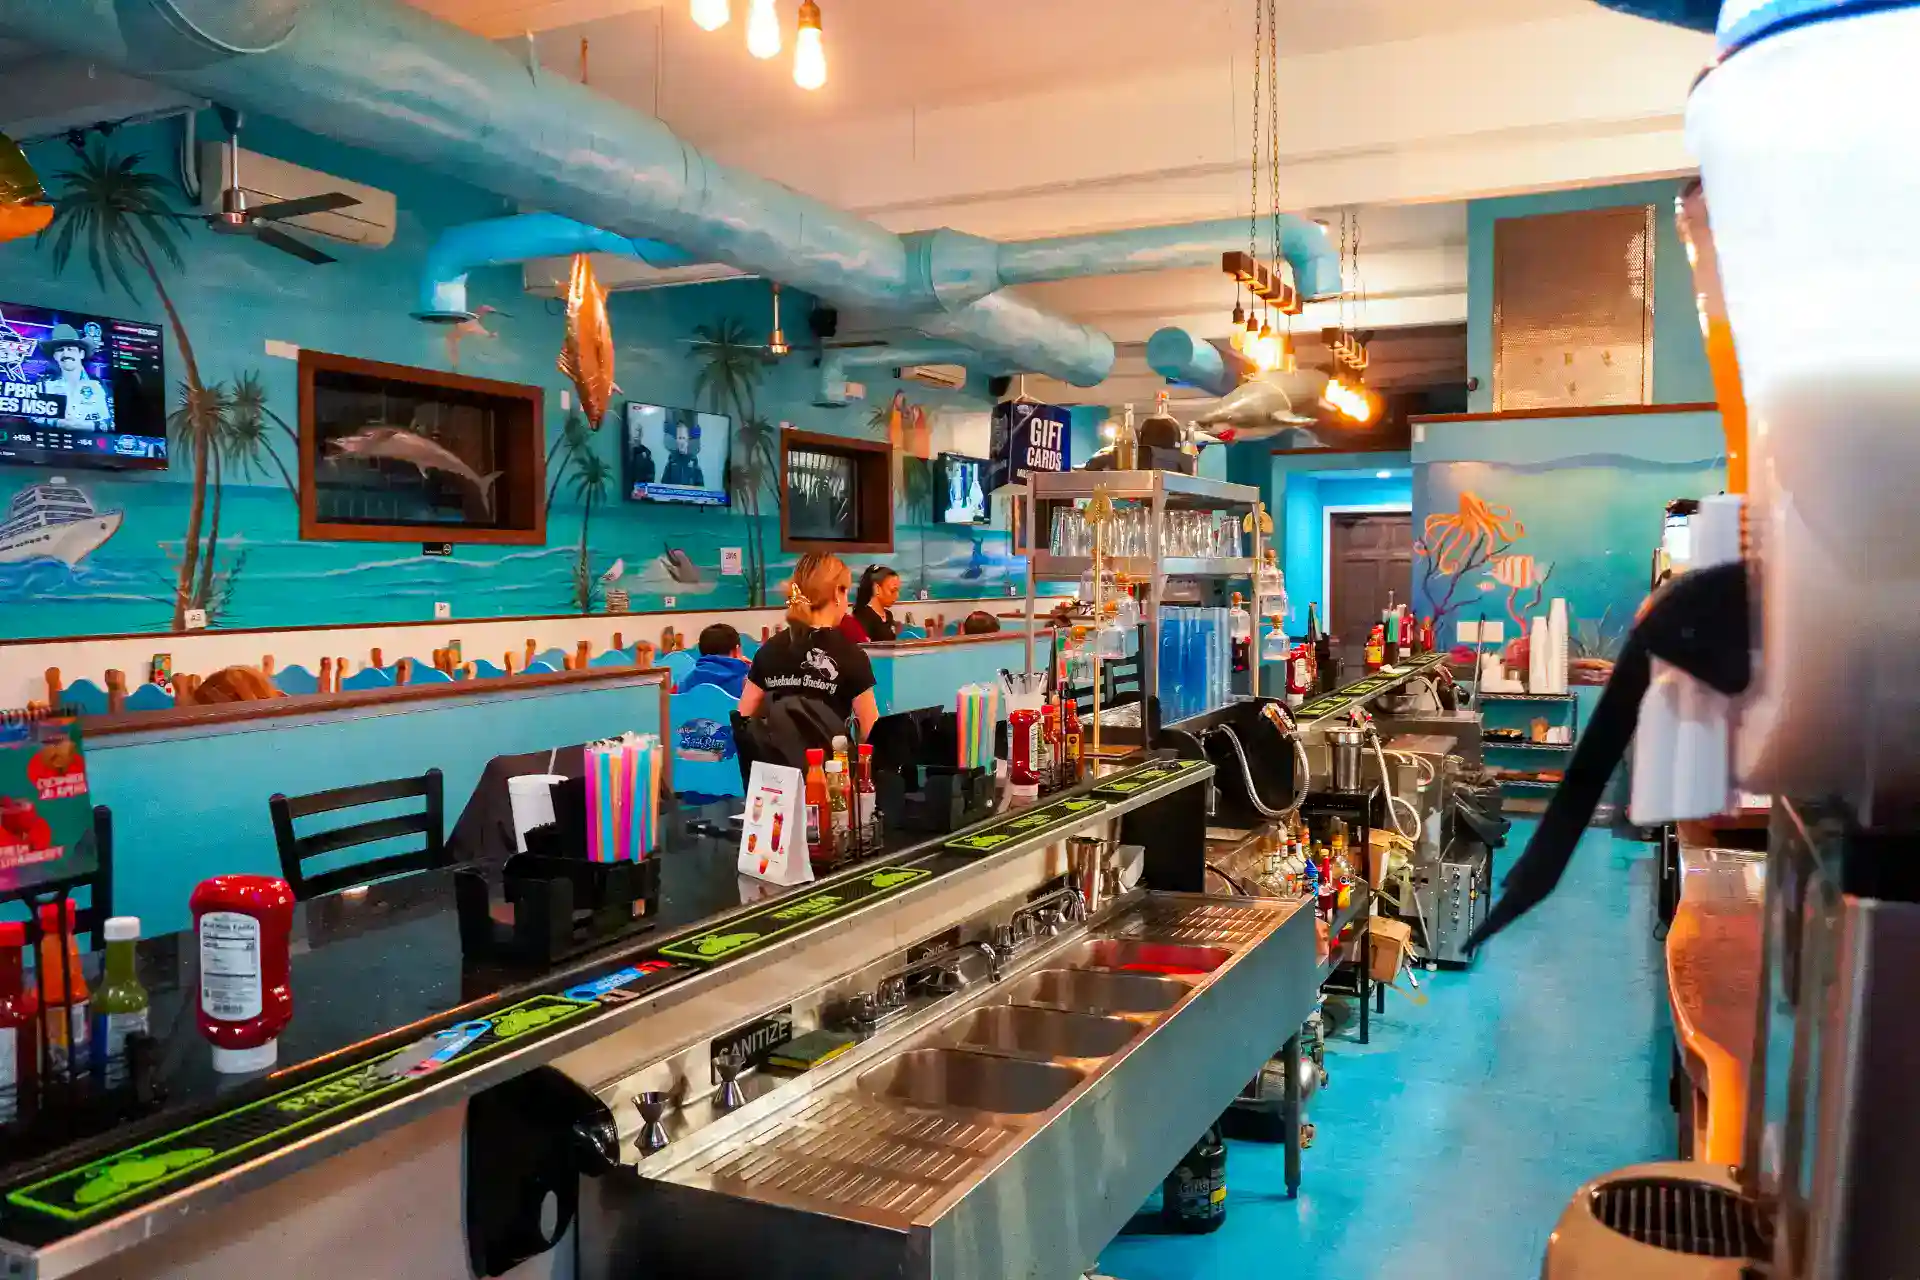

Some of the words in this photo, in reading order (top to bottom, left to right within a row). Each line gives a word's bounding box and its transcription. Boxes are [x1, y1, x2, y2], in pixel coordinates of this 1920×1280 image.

[4, 381, 38, 399] PBR
[21, 398, 58, 416] MSG
[1030, 417, 1064, 451] GIFT
[1026, 446, 1062, 472] CARDS
